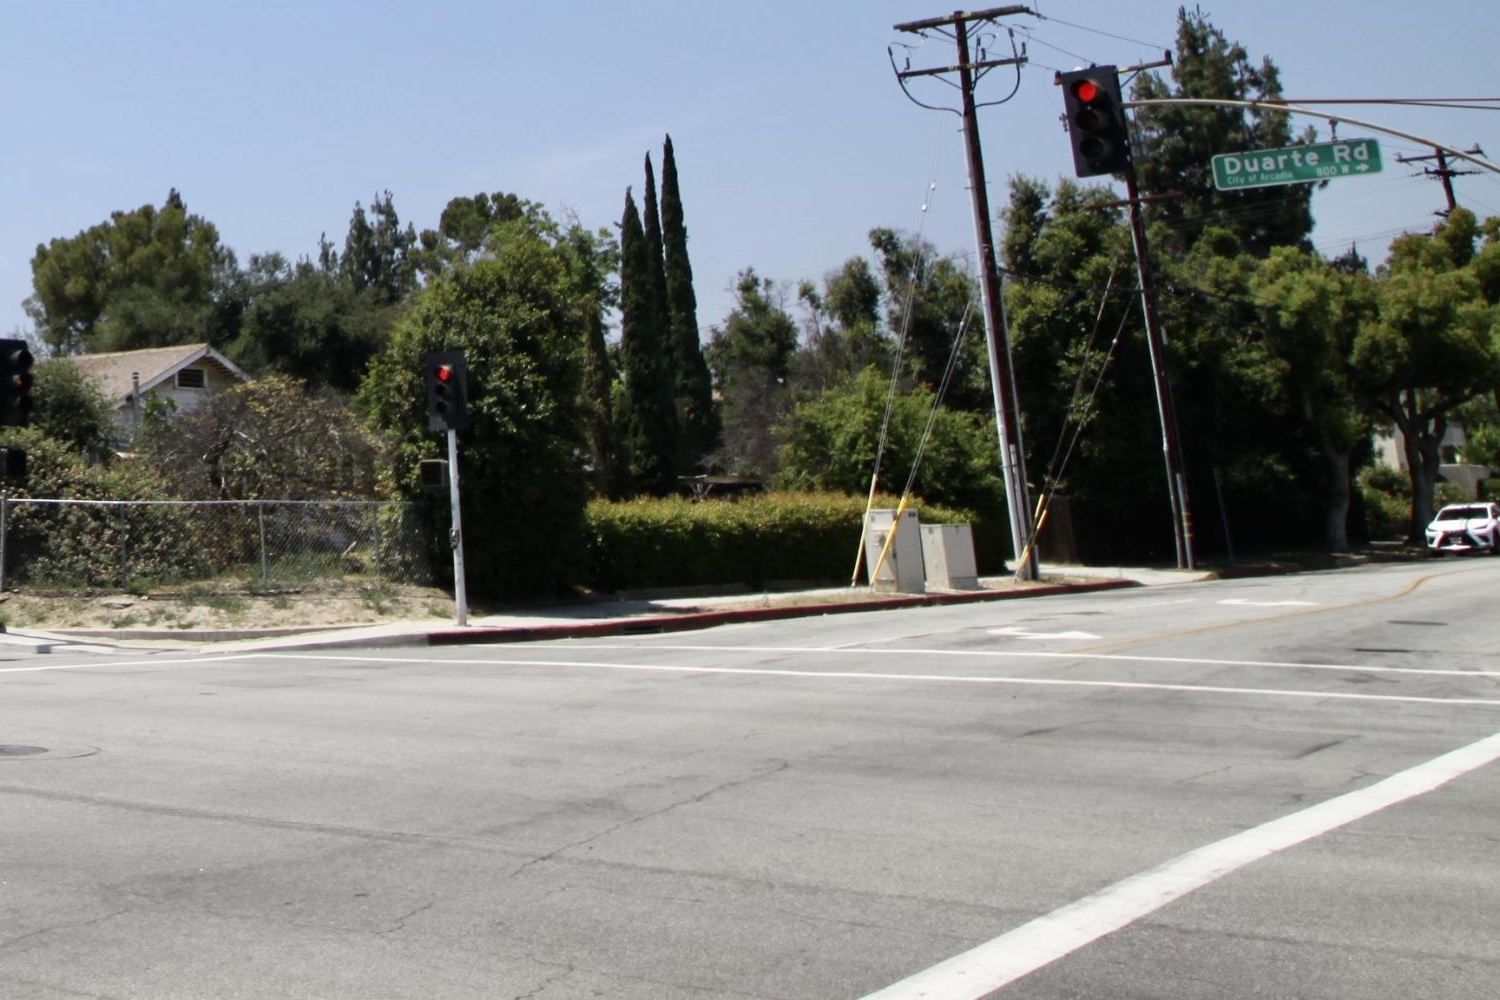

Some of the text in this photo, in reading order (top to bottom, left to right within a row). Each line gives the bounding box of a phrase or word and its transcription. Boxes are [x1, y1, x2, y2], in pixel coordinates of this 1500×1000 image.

[1223, 142, 1369, 175] Duarte Rd
[1227, 175, 1245, 186] City
[1260, 170, 1294, 182] Arcadia
[1316, 164, 1350, 177] 800 W
